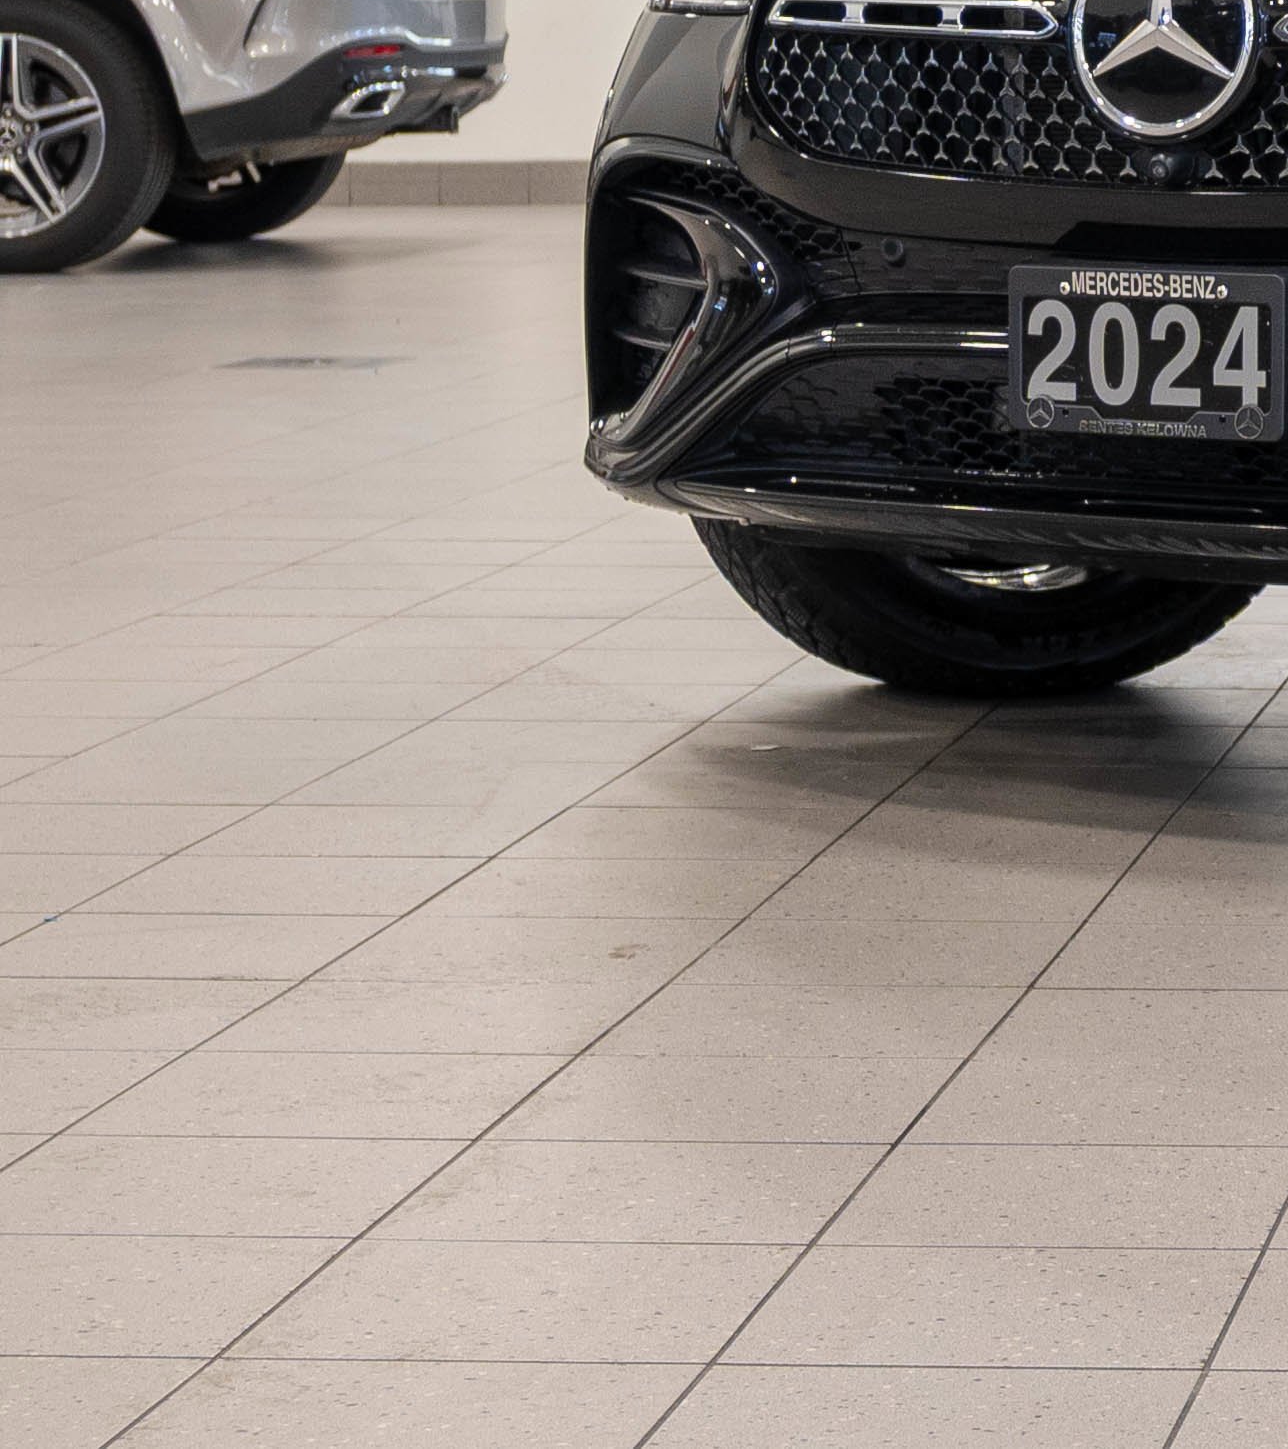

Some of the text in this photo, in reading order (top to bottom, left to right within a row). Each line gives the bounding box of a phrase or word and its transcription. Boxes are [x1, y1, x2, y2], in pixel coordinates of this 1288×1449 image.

[1072, 271, 1216, 299] MERCEDES-BENZ
[1026, 299, 1267, 408] 2024
[1136, 422, 1207, 439] KELOWNA
